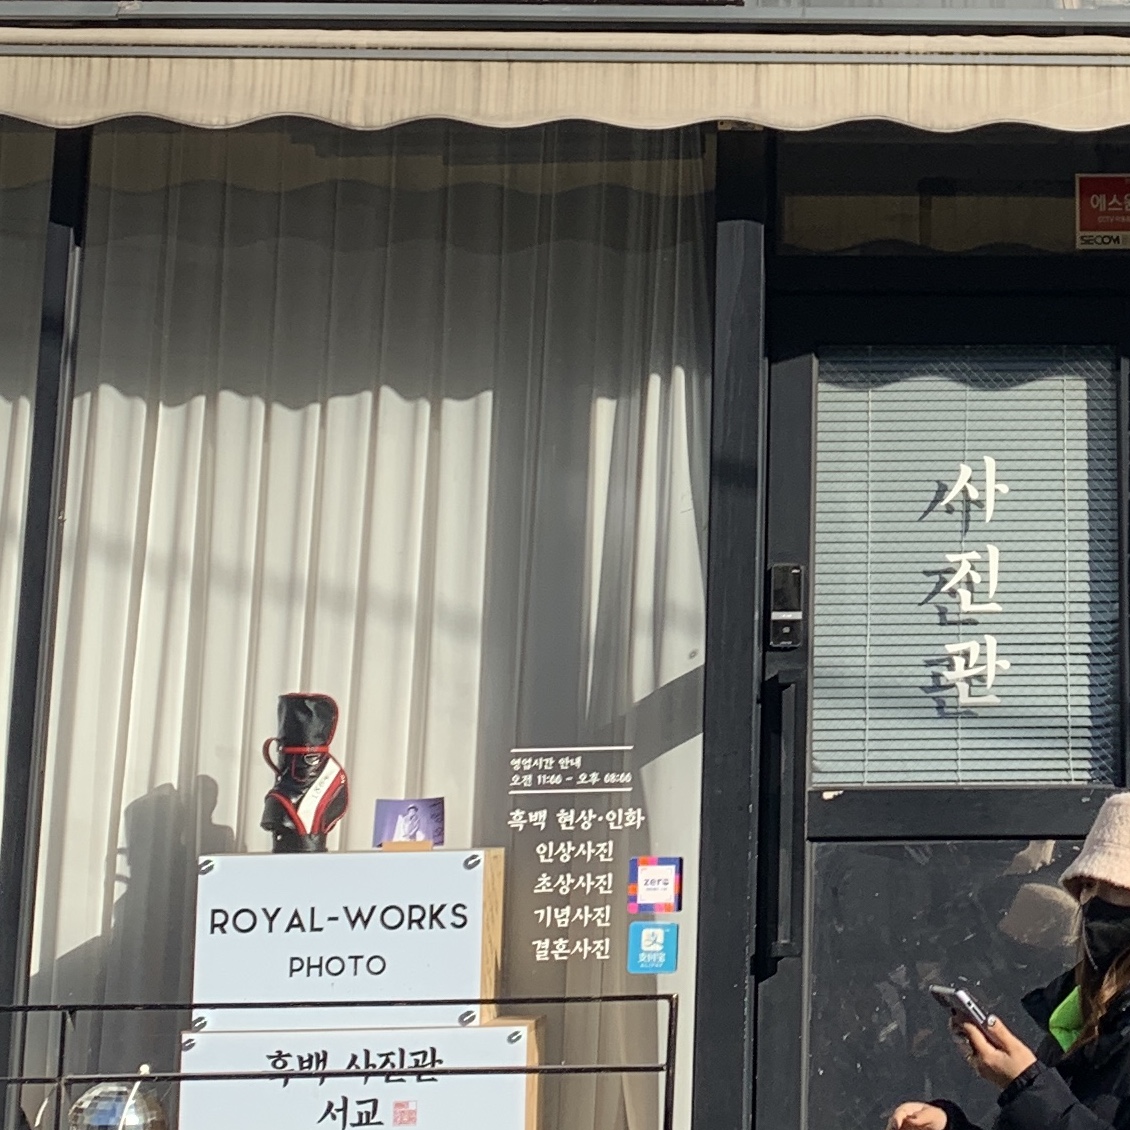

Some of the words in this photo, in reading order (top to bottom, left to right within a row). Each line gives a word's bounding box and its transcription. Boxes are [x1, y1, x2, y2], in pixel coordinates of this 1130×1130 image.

[1080, 235, 1120, 245] SECOM
[940, 455, 1011, 706] 사진관
[510, 757, 555, 770] 영업시간
[558, 756, 582, 769] 안내
[510, 774, 533, 787] 오전
[576, 772, 601, 785] 오후
[507, 808, 548, 831] 흑백
[535, 840, 614, 863] 인상사진
[533, 873, 613, 895] 초상사진
[209, 902, 469, 935] ROYAL-WORKS
[533, 905, 611, 928] 기념사진
[531, 938, 610, 961] 결혼사진
[288, 954, 387, 978] PHOTO
[346, 1046, 444, 1085] 사진관
